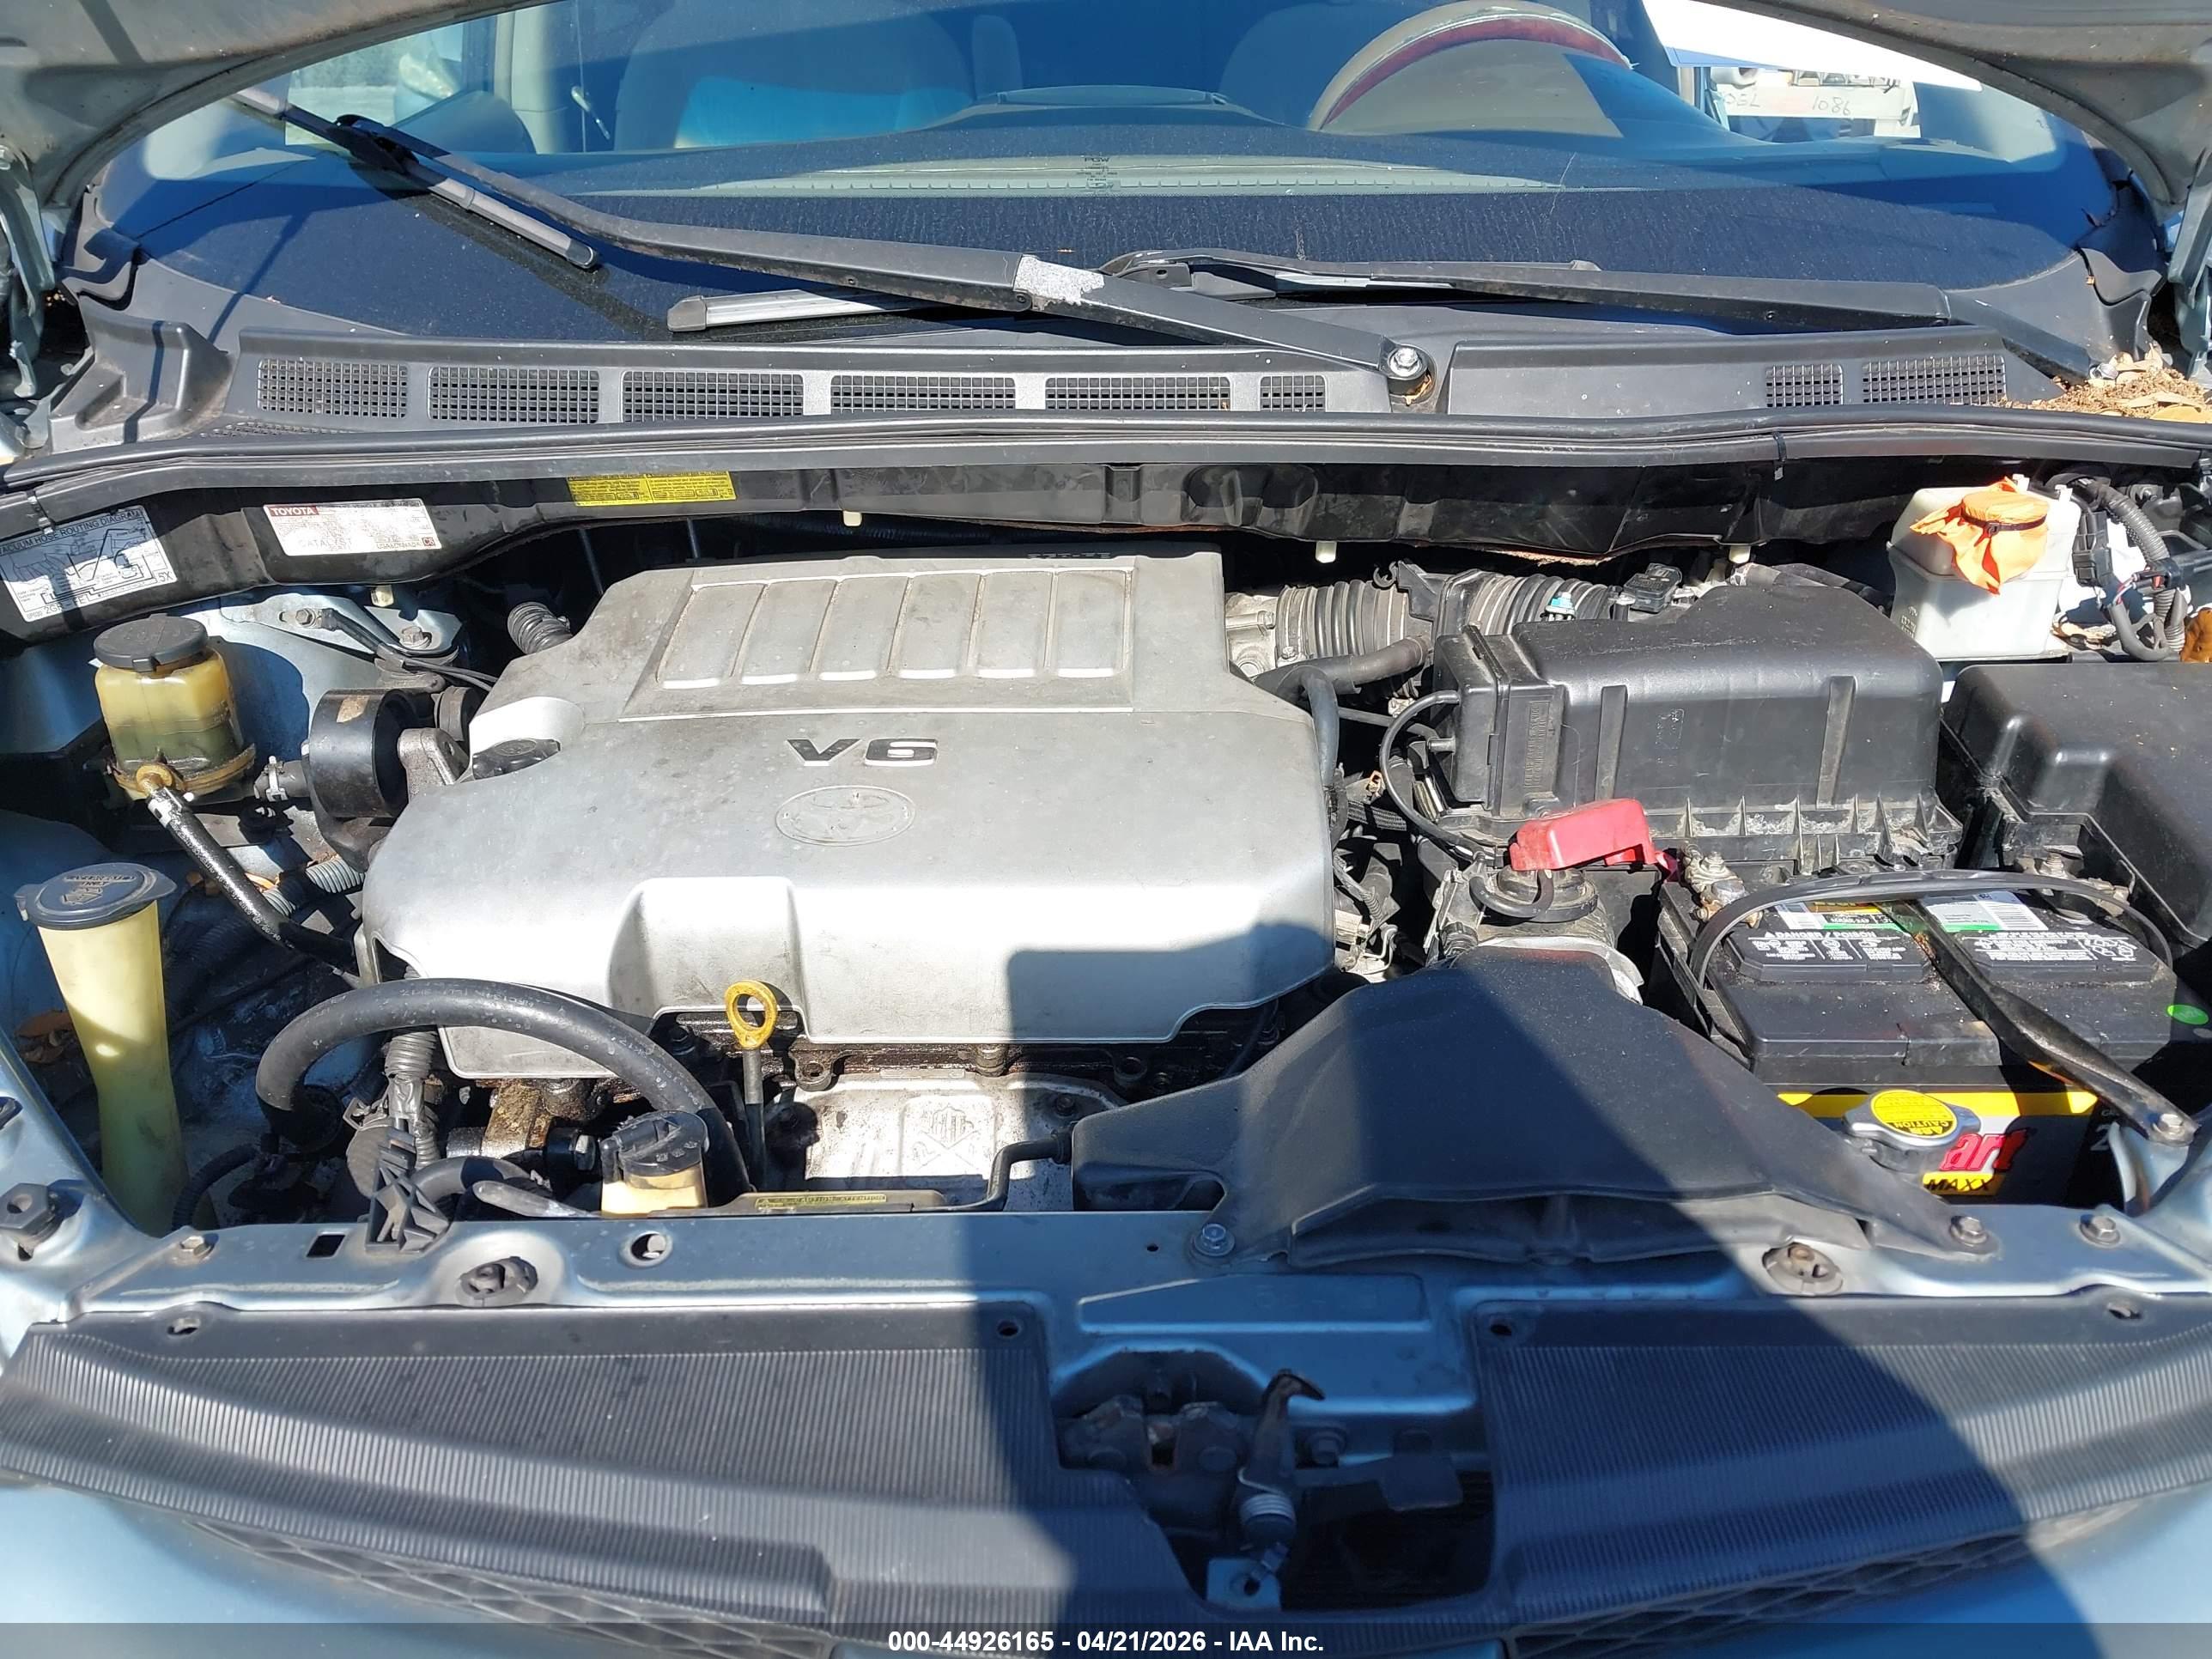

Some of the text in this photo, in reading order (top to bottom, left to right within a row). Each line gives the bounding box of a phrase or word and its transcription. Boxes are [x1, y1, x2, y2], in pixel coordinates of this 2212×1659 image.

[1812, 95, 1852, 117] 1086
[61, 520, 100, 537] ROUTING
[100, 507, 144, 526] DIAGRAM
[270, 507, 316, 516] TOYOTA
[787, 738, 939, 767] V6
[1939, 1129, 2027, 1171] art
[1924, 1179, 1989, 1191] MAXX
